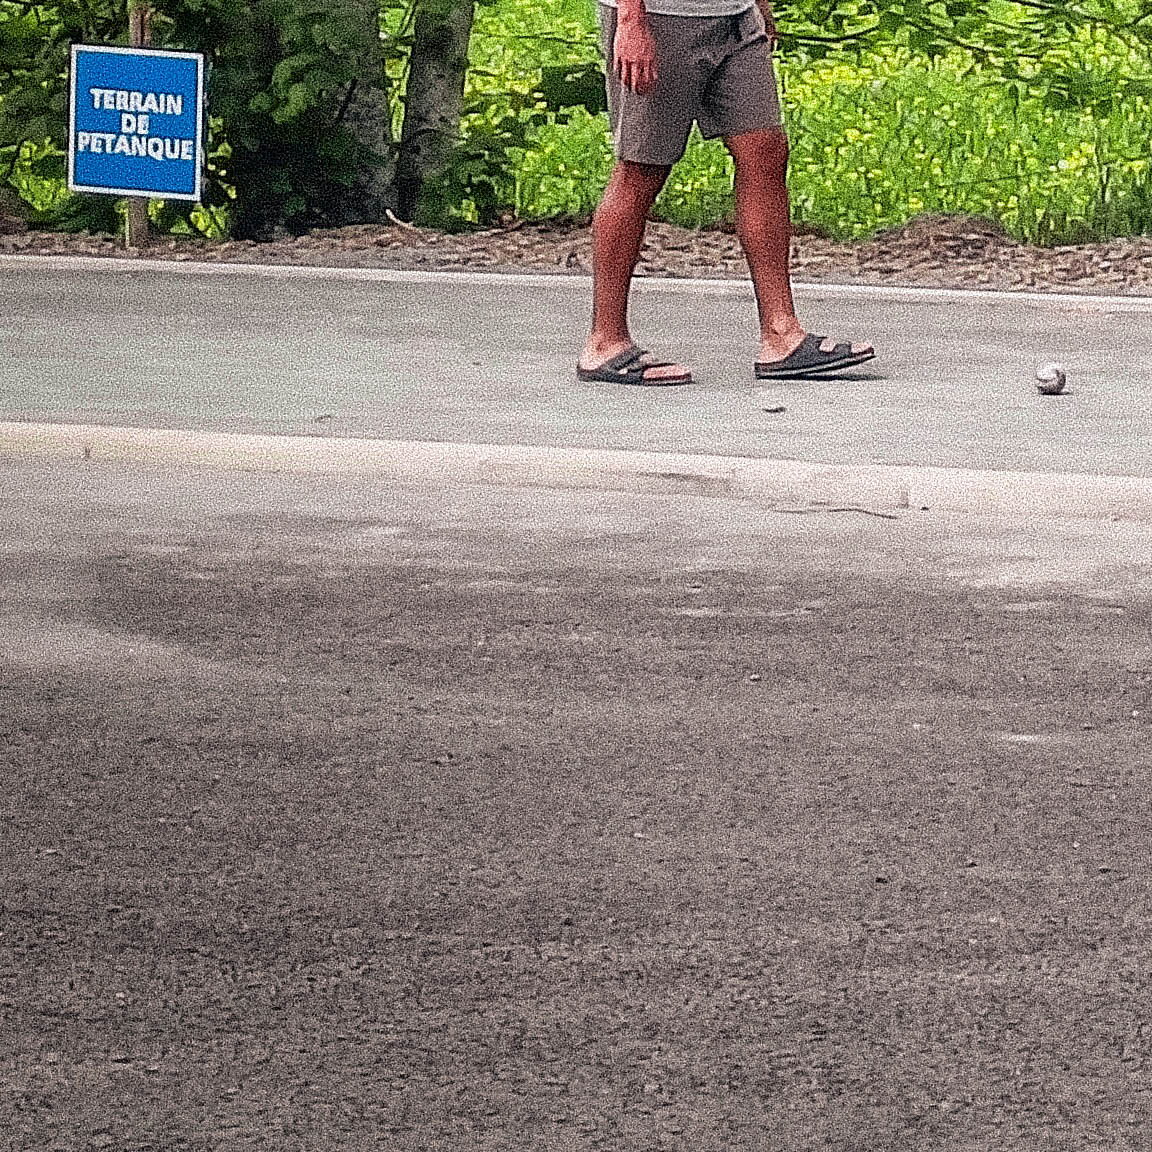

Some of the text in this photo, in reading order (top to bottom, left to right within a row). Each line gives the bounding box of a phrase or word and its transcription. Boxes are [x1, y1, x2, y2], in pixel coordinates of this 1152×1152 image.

[90, 88, 182, 115] TERRAIN
[121, 113, 149, 135] DE
[77, 132, 193, 160] PETANQUE
